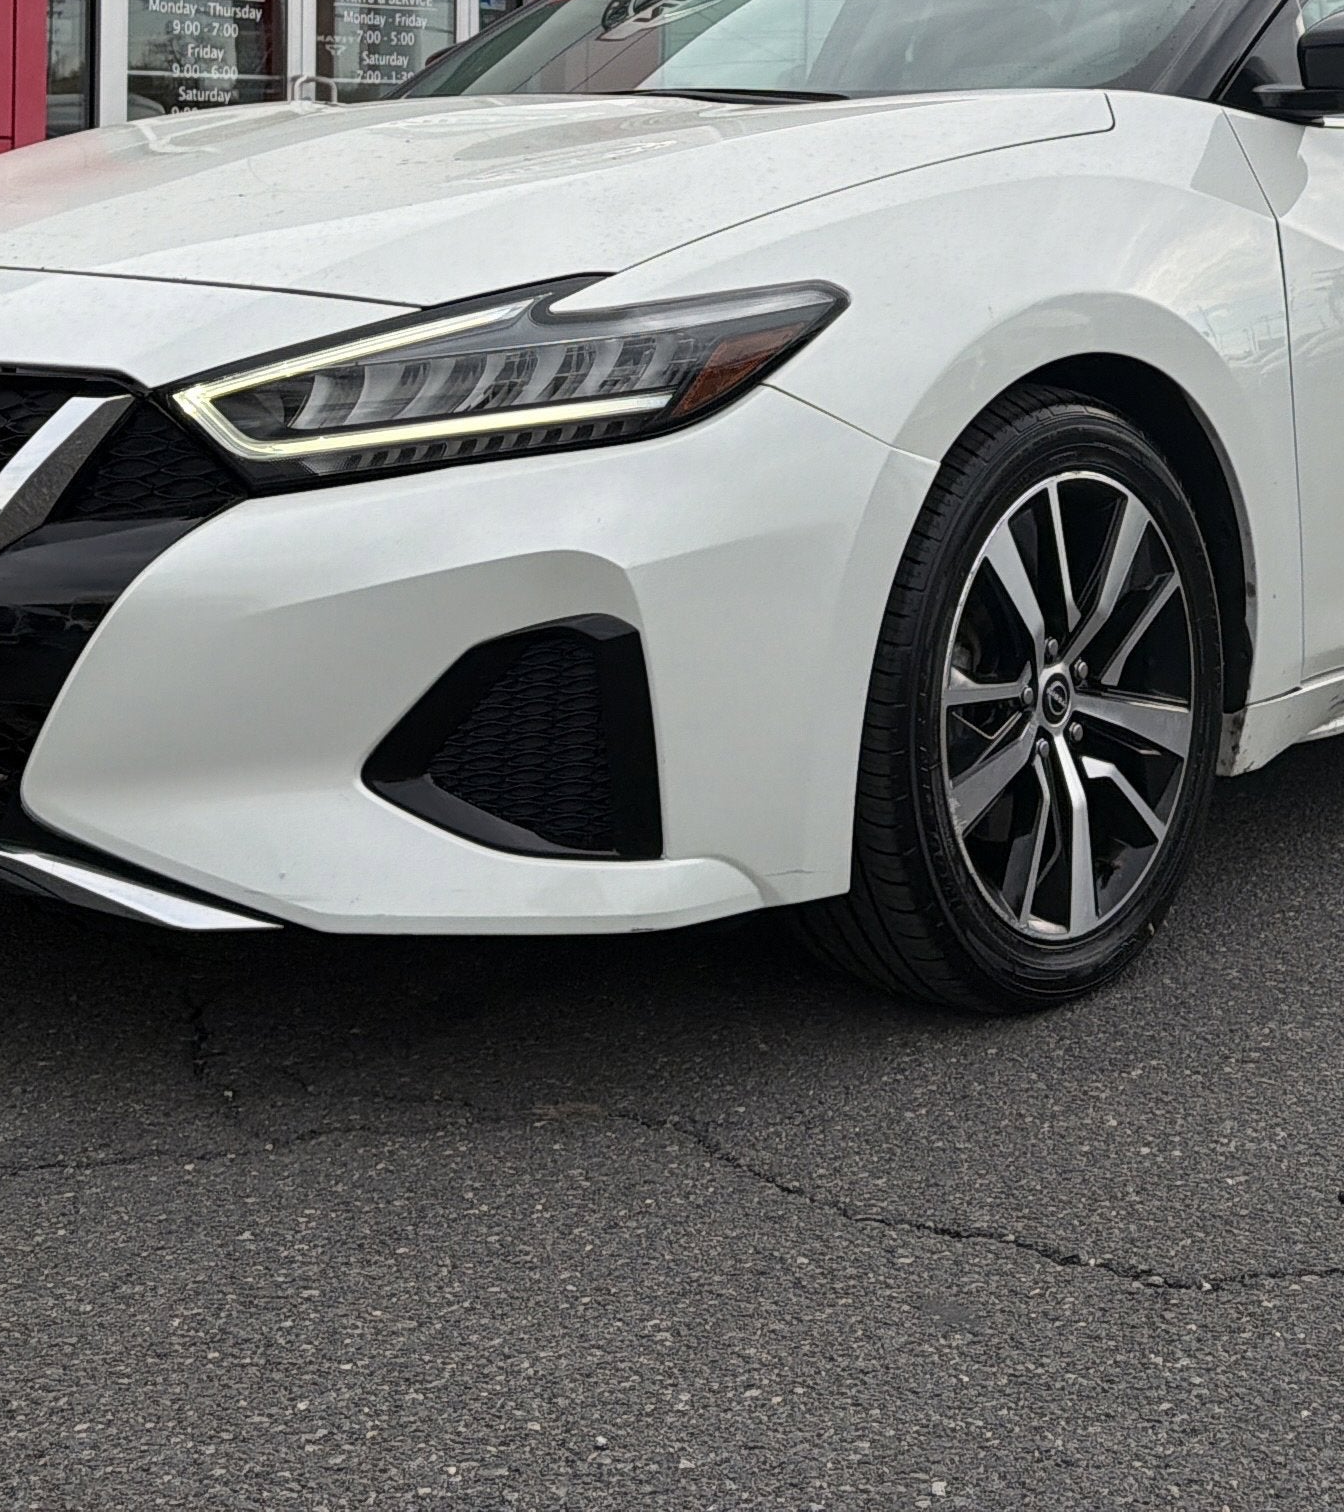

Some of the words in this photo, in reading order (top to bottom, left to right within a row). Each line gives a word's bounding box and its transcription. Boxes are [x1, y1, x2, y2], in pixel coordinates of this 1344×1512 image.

[208, 2, 262, 22] Thursday
[343, 11, 386, 28] Monday
[395, 12, 427, 29] Friday
[172, 20, 201, 36] 9:00
[212, 23, 239, 38] 7:00
[357, 30, 381, 44] 7:00
[390, 32, 415, 46] 5:00
[187, 44, 224, 61] Friday
[362, 51, 409, 68] Saturday
[172, 63, 200, 79] 9:00
[211, 65, 238, 80] 6:00
[357, 70, 381, 84] 7:00
[178, 86, 232, 104] Saturday
